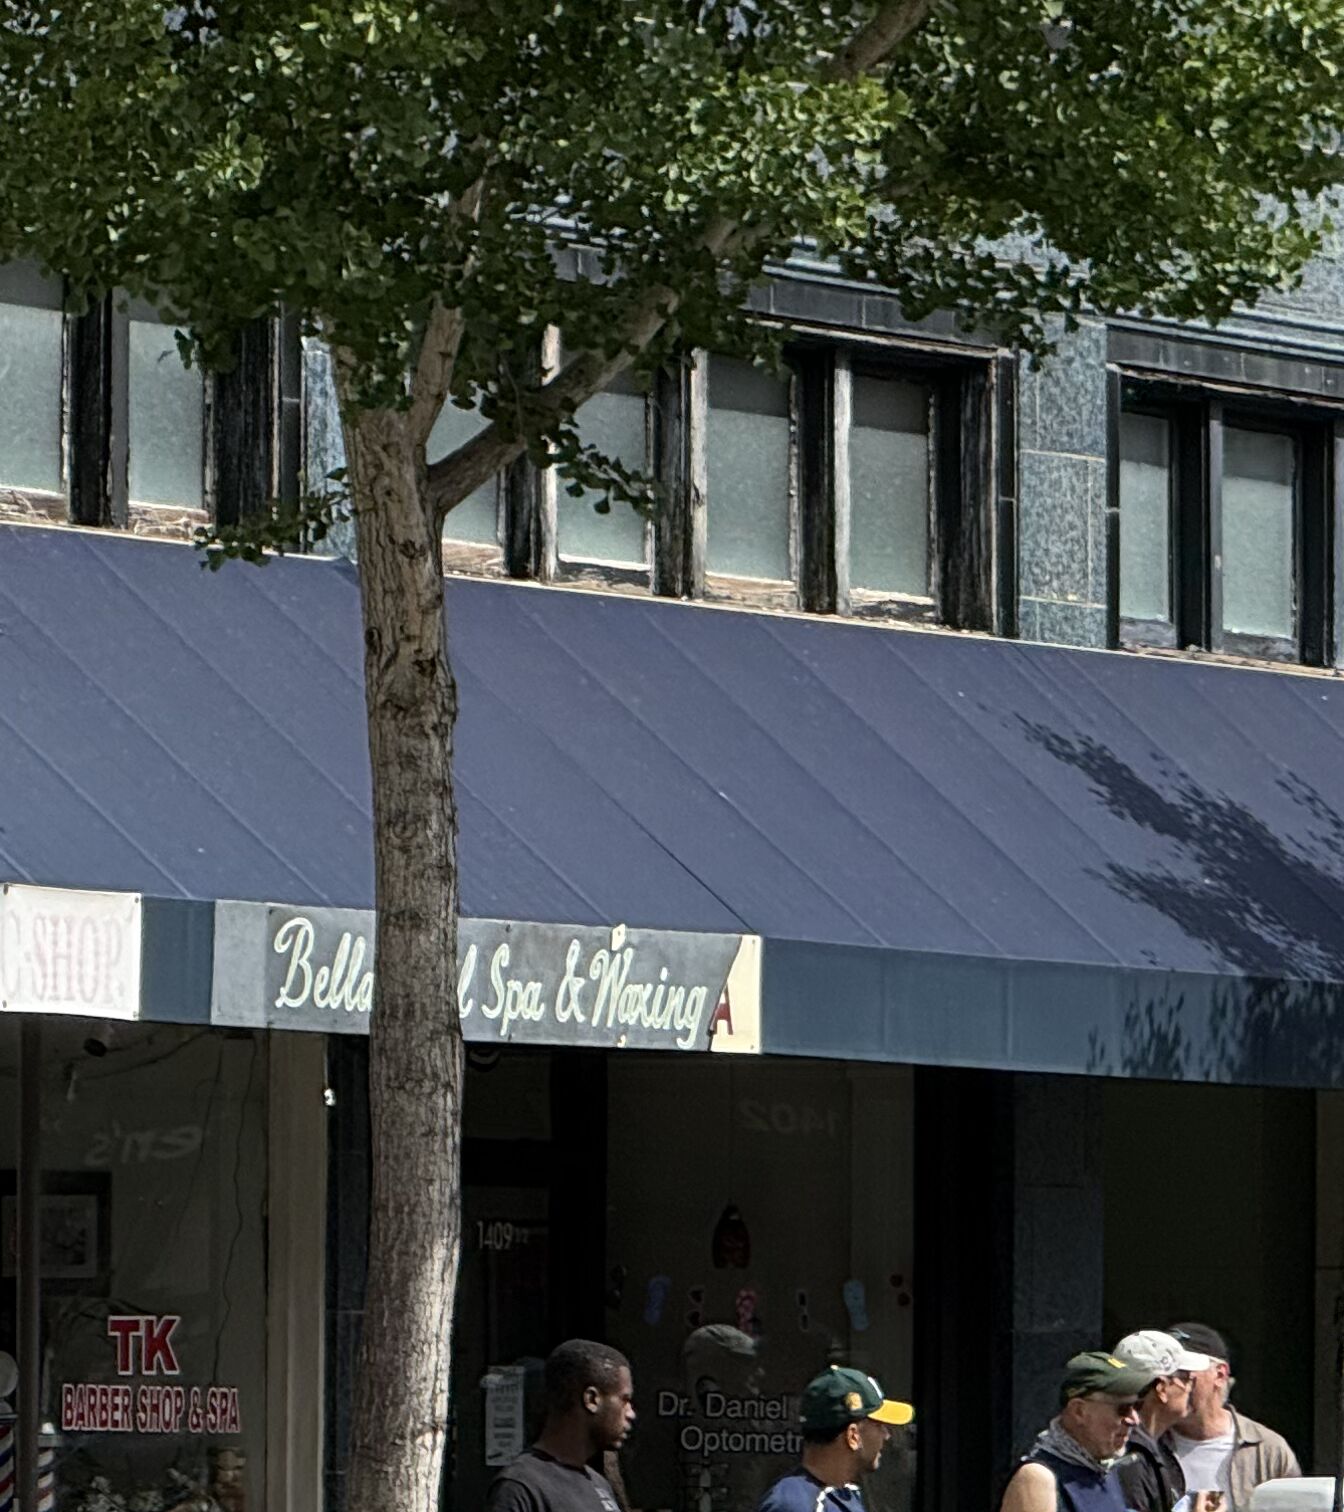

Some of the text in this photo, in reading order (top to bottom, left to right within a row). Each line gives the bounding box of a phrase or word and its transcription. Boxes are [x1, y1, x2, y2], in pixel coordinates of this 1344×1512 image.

[274, 917, 374, 1012] Bella
[482, 942, 545, 1037] Spa
[555, 938, 586, 1023] &
[589, 946, 708, 1049] Waxing
[107, 1315, 181, 1376] TK
[61, 1383, 241, 1434] BARBER SHOP & SPA
[658, 1391, 788, 1419] Dr. Daniel
